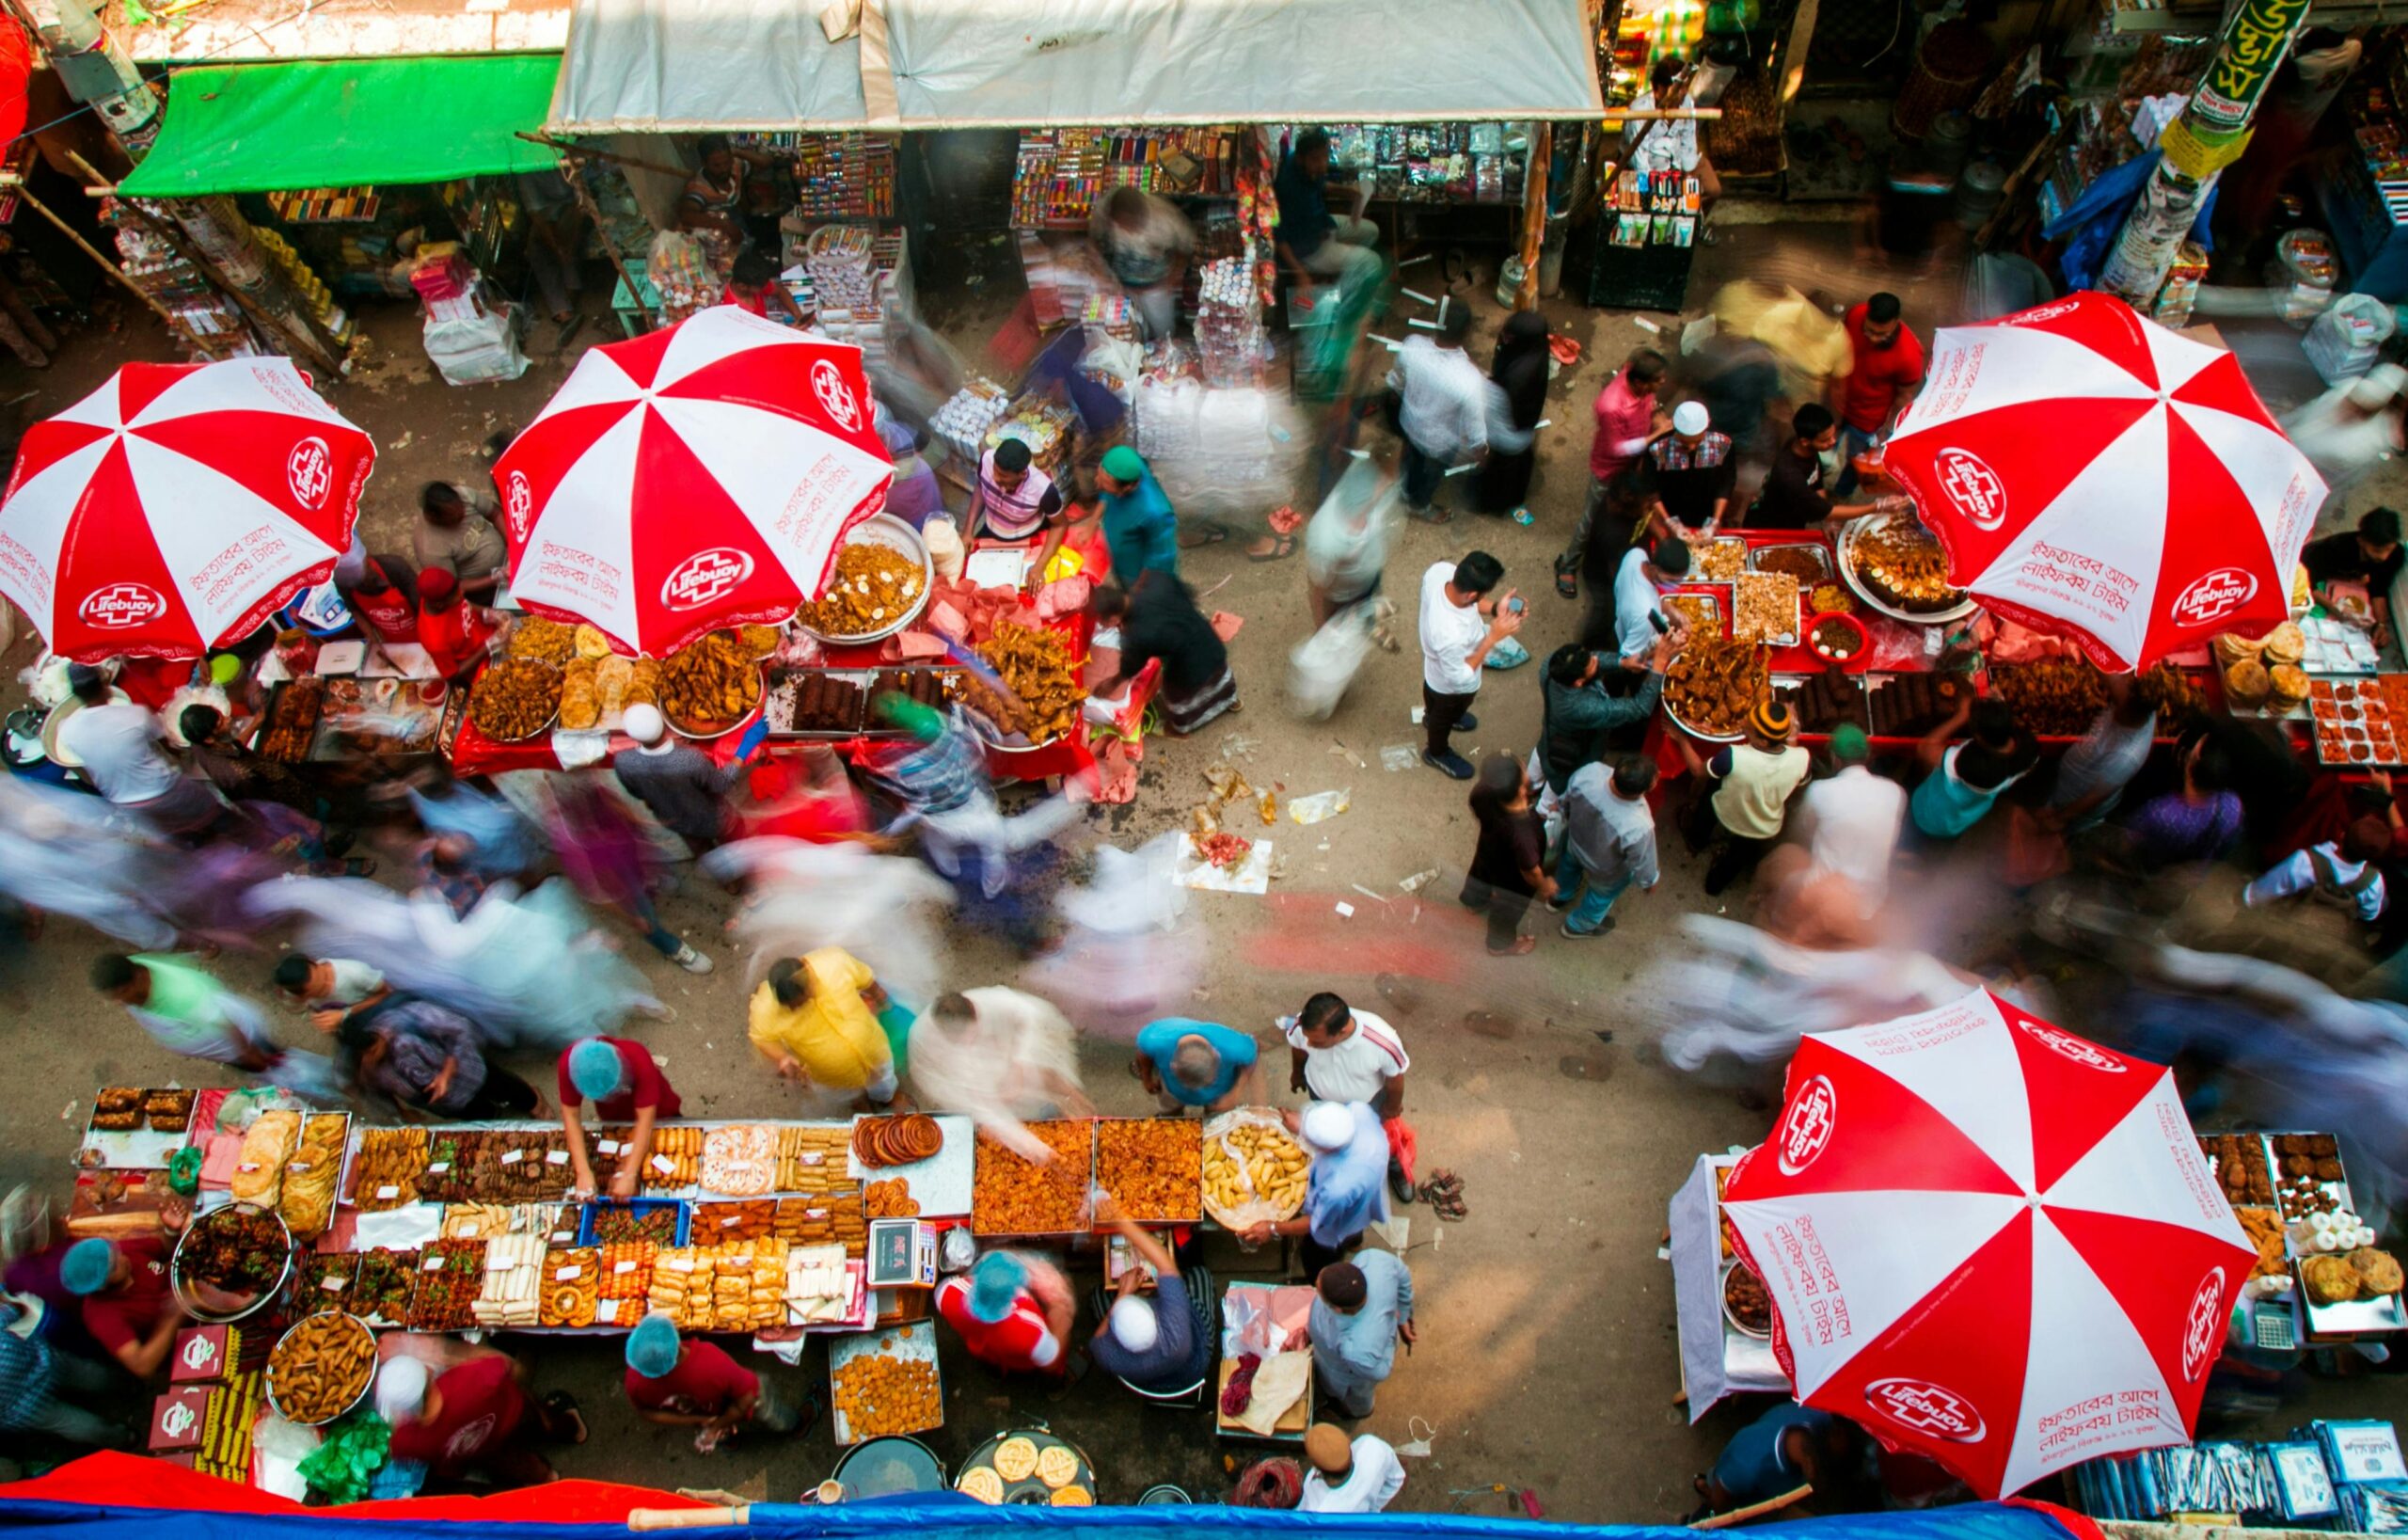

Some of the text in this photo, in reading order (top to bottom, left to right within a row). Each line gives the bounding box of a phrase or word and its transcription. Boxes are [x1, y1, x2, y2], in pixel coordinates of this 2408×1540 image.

[296, 445, 323, 500] Lifebuoy
[809, 453, 833, 476] আগে
[823, 466, 850, 488] টাইম
[1948, 453, 1992, 517] Lifebuoy
[243, 525, 272, 545] আগে
[251, 539, 286, 561] টাইম
[594, 578, 618, 598] টাইম
[598, 561, 621, 578] আগে
[671, 563, 740, 596] Lifebuoy
[2022, 563, 2129, 612] লাইফবয় টাইম
[2032, 541, 2138, 591] ইফতারের আগে
[88, 598, 155, 613] Lifebuoy
[2181, 585, 2246, 611] Lifebuoy
[1787, 1086, 1829, 1165] Lifebuoy
[1776, 1226, 1833, 1345] লাইফবয় টাইম
[1795, 1215, 1851, 1338] ইফতারের আগে
[2186, 1279, 2218, 1367] Lifebuoy
[1880, 1383, 1972, 1432] Lifebuoy
[2038, 1389, 2159, 1434] ইফতারের আগে
[2039, 1405, 2160, 1451] লাইফবয় টাইম
